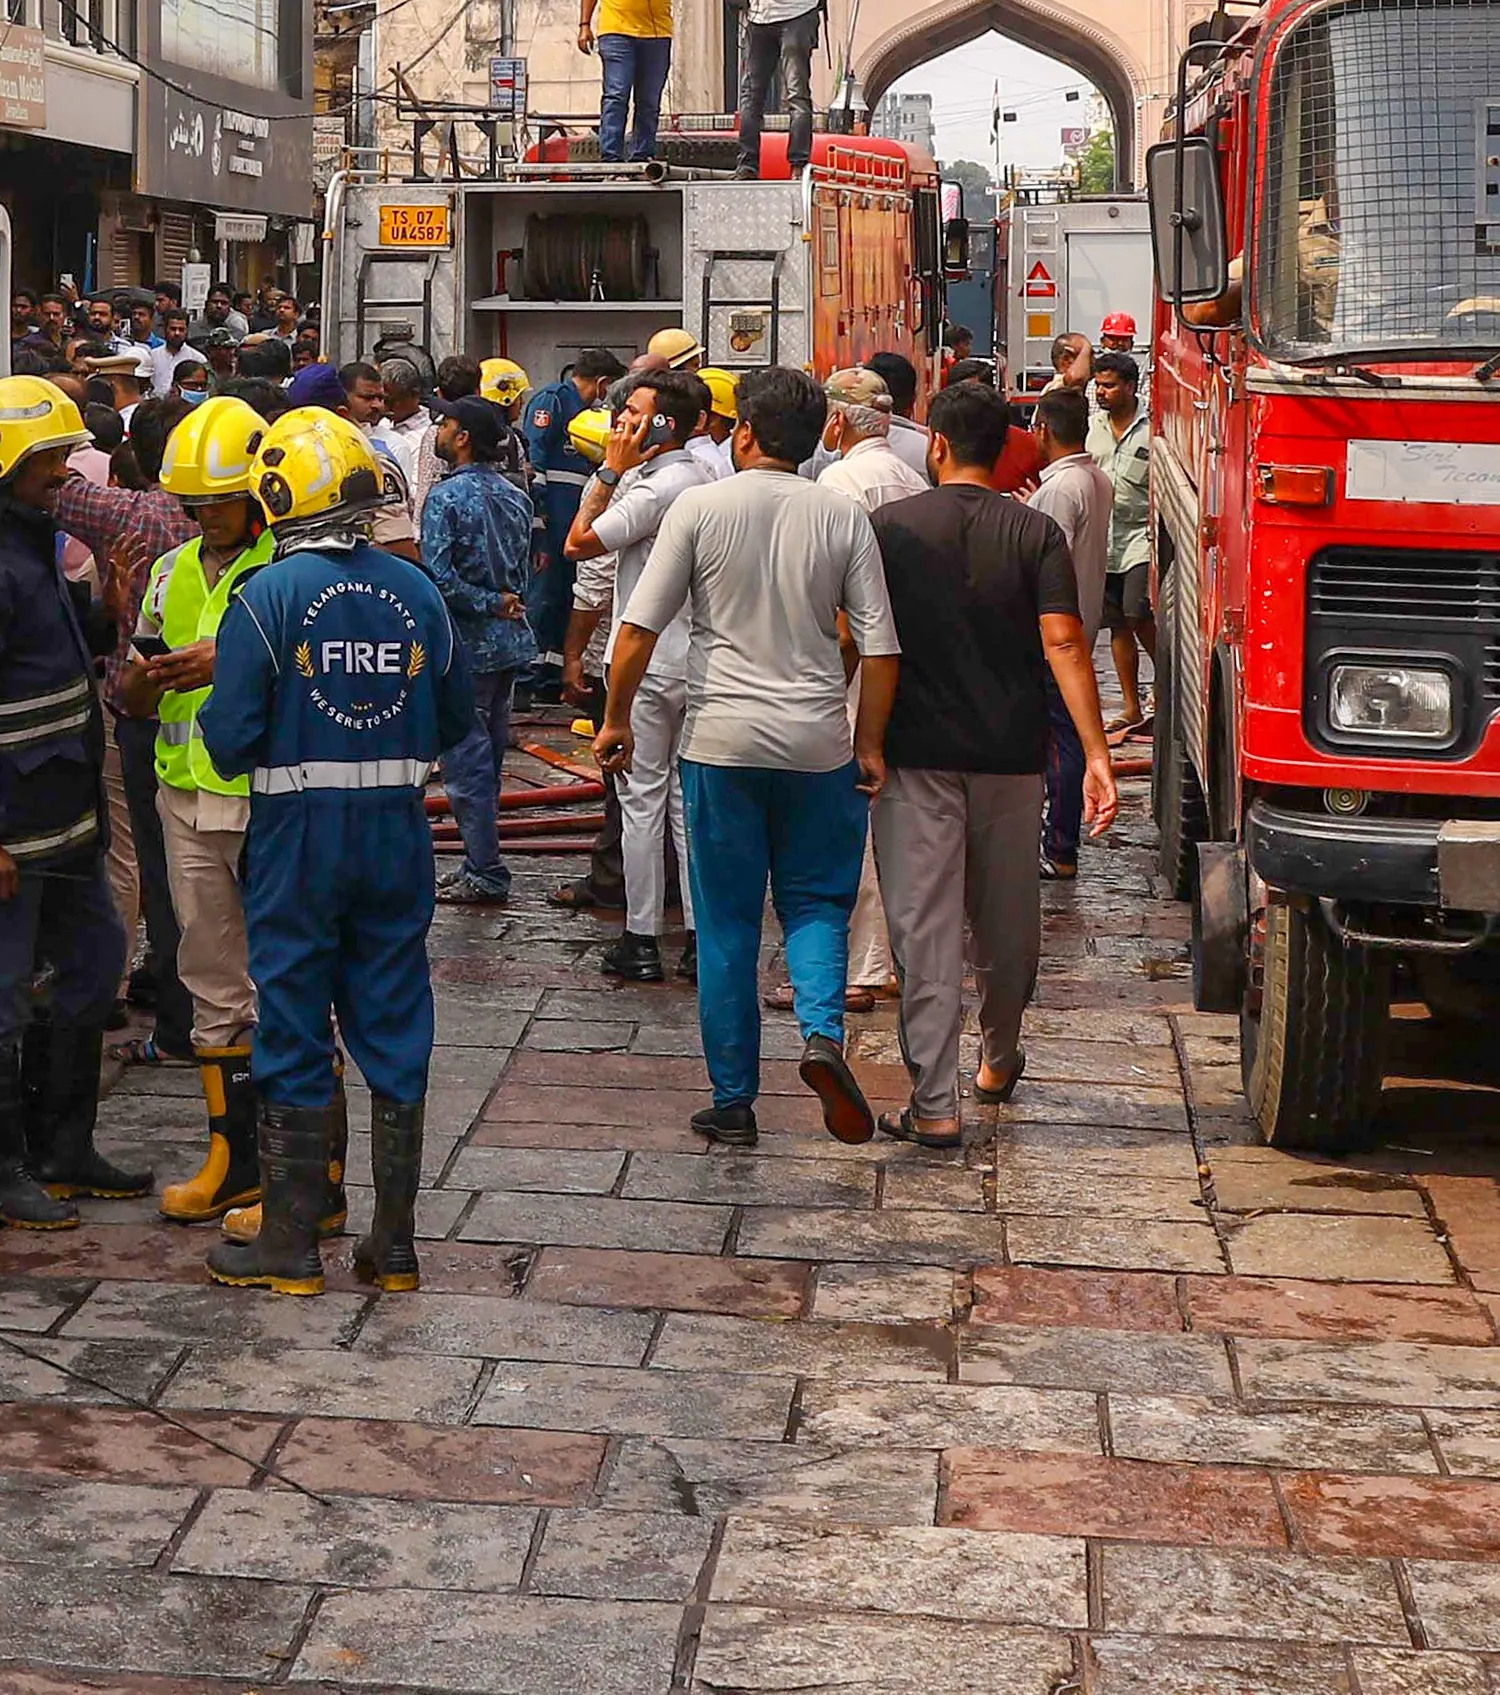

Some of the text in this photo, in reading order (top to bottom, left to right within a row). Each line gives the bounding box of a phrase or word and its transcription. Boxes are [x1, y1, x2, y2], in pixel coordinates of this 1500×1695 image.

[392, 226, 444, 241] UA4587
[416, 210, 433, 225] 07
[302, 582, 416, 630] TELANGANA STATE
[321, 640, 402, 674] FIRE
[310, 688, 326, 710] WE
[366, 715, 381, 728] TO
[382, 688, 408, 721] SAVE
